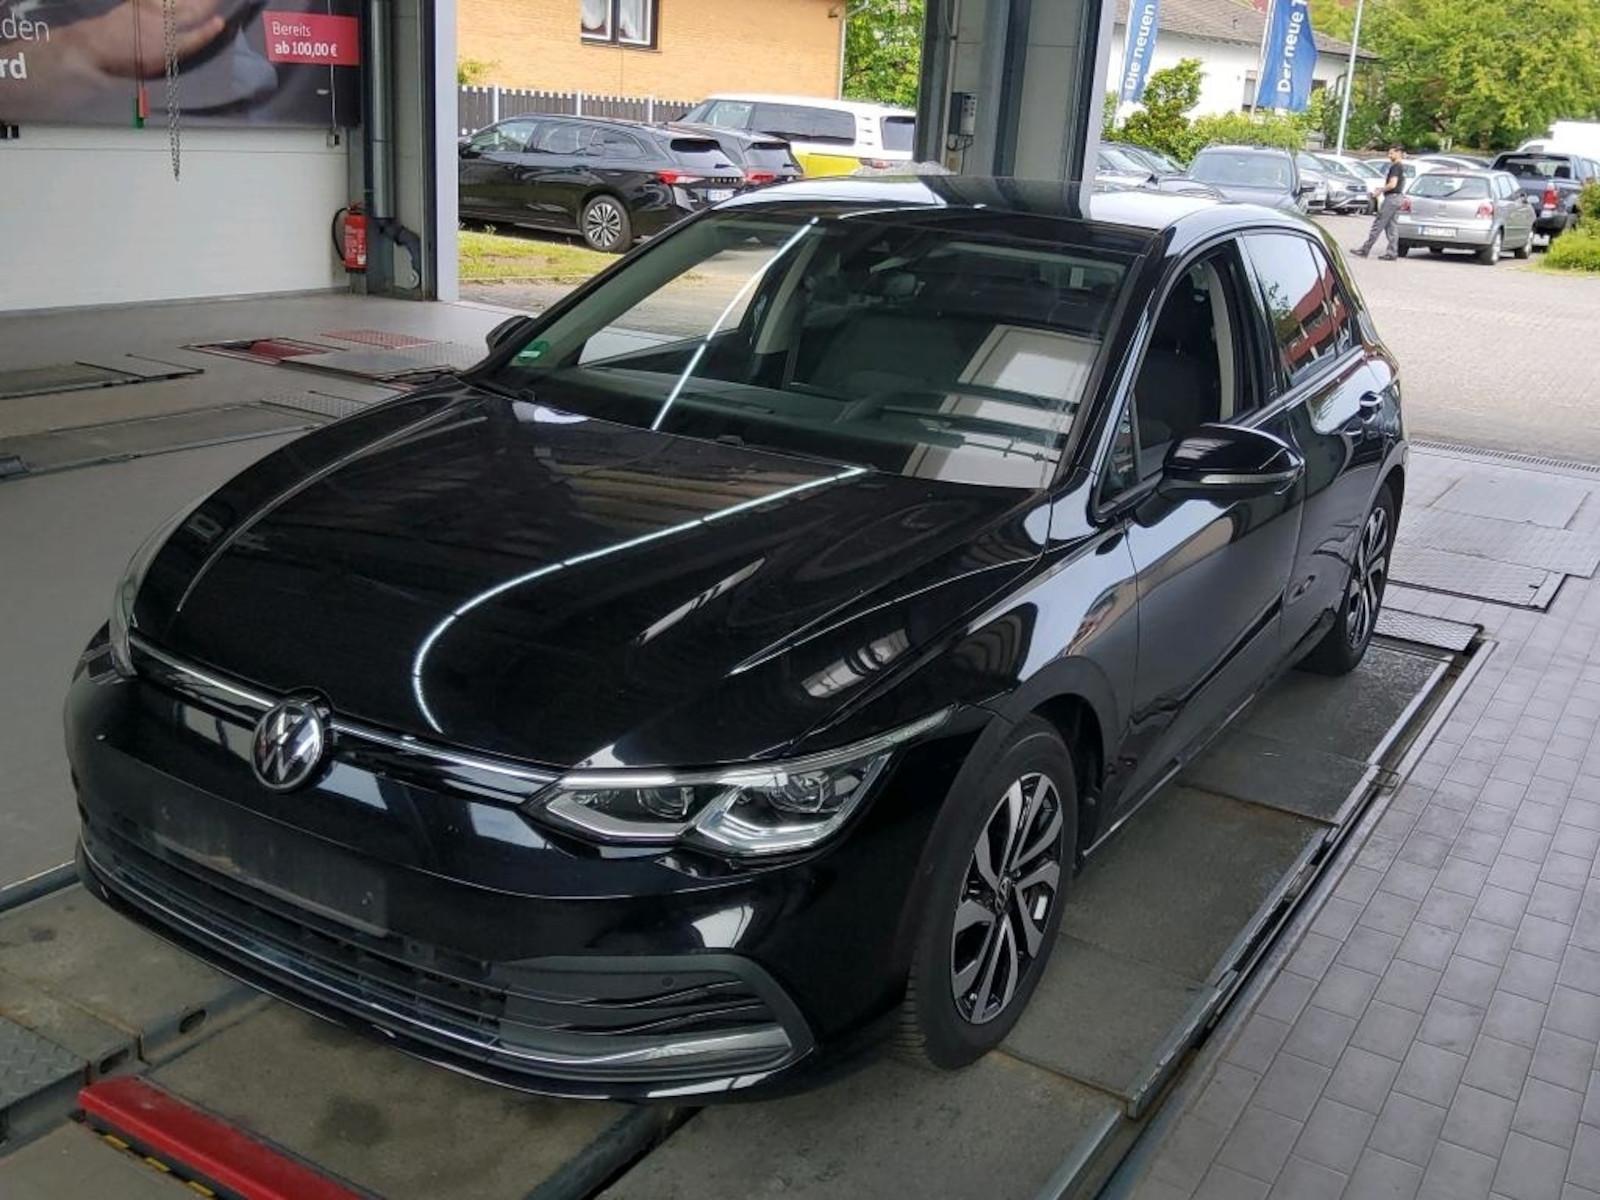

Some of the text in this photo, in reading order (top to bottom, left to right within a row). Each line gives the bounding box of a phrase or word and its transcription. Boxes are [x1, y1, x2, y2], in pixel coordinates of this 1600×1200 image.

[0, 9, 50, 42] den
[272, 20, 311, 37] Bereits
[1284, 11, 1304, 57] neue
[275, 41, 338, 57] ab 100,00 €
[1125, 3, 1155, 90] Die neuen
[1277, 61, 1292, 92] Der
